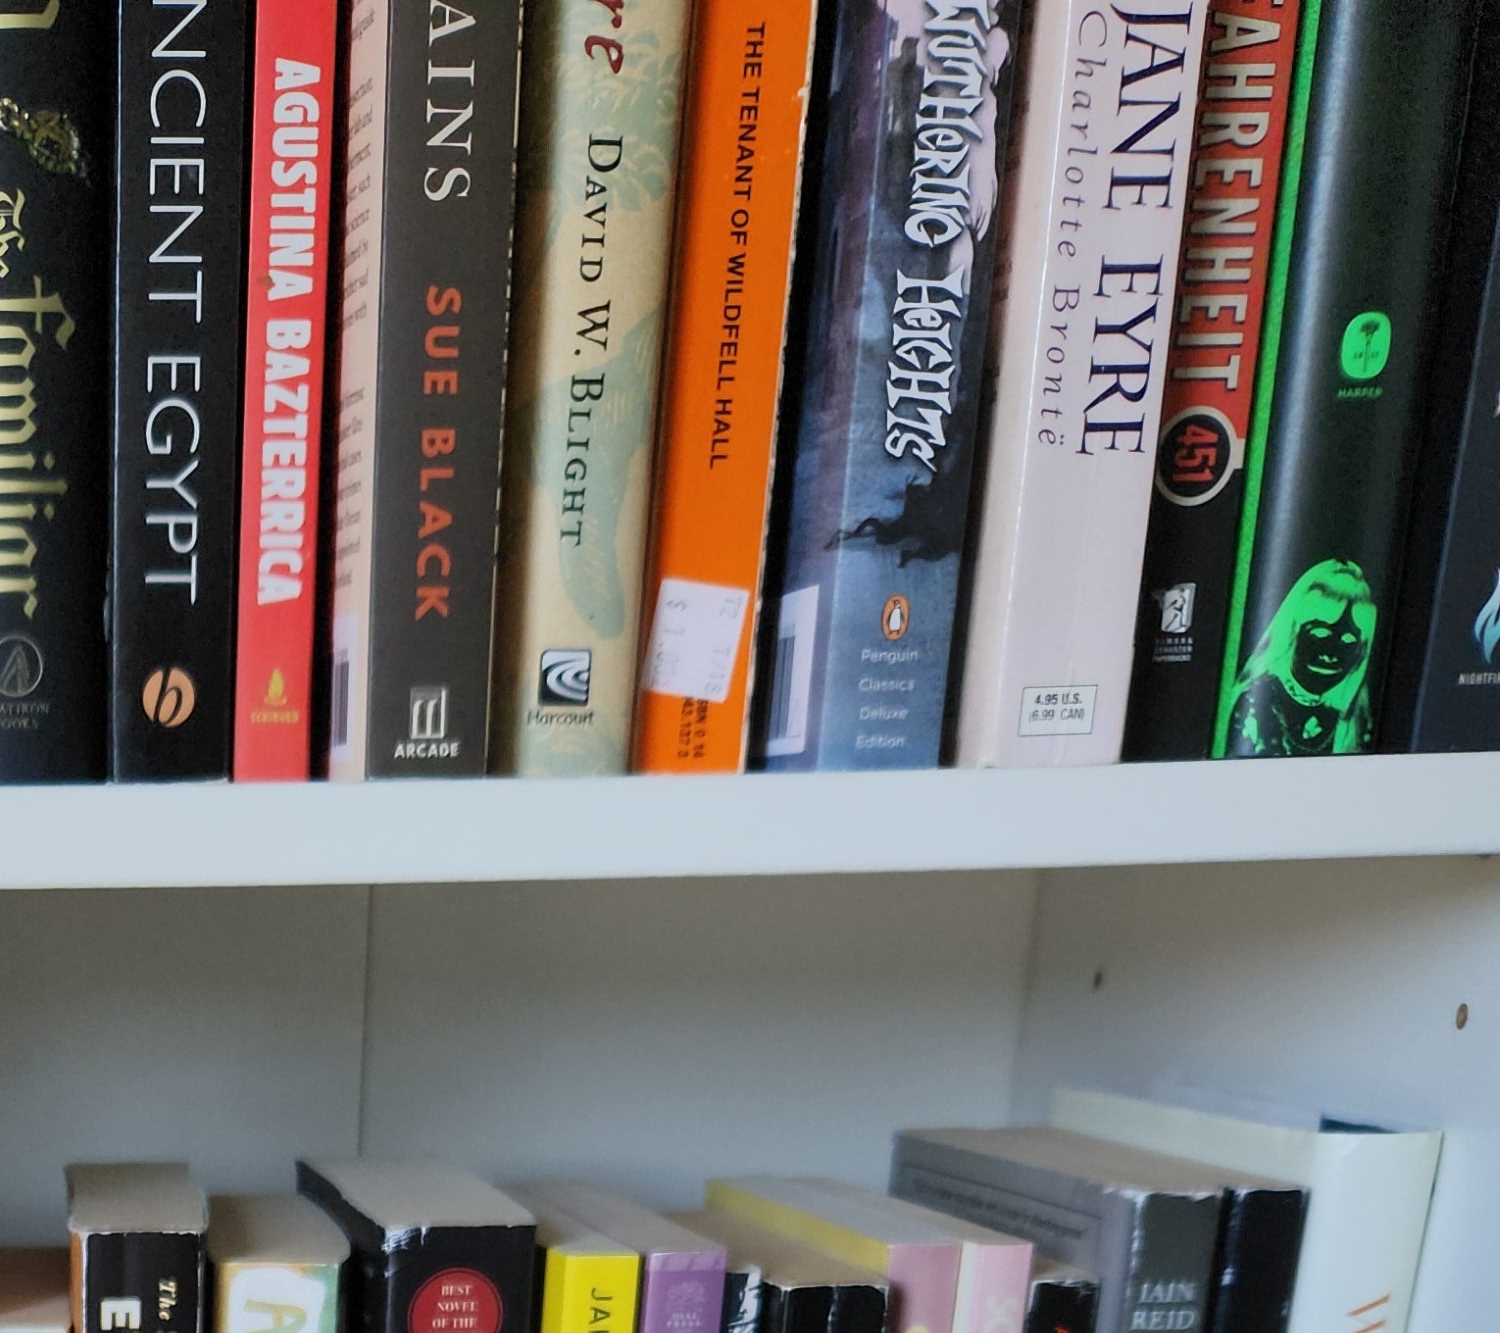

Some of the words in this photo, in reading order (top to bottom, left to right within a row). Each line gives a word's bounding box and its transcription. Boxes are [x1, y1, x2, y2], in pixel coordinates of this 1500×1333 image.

[744, 22, 766, 77] THE
[1056, 8, 1109, 259] Charlotte
[1102, 1, 1193, 212] JANE
[736, 84, 762, 202] TENANT
[265, 58, 320, 302] AGUSTINA
[579, 133, 624, 284] DAVID
[1173, 0, 1286, 392] AHRENHEIT
[729, 209, 751, 247] OF
[424, 285, 462, 395] SUE
[572, 299, 612, 357] W.
[716, 252, 748, 393] WILDFELL
[1036, 283, 1081, 448] Brontë
[1075, 253, 1165, 458] EYRE
[1338, 388, 1383, 399] HARPER
[256, 319, 312, 606] BAZTERRICA
[559, 375, 605, 547] BLIGHT
[709, 399, 734, 470] HALL
[1172, 424, 1222, 483] 451
[142, 355, 202, 604] EGYPT
[414, 428, 456, 621] BLACK
[858, 678, 915, 692] Classics
[861, 650, 919, 665] Penguin
[526, 710, 594, 727] Harcourt
[859, 706, 909, 720] Deluxe
[1034, 693, 1059, 706] 4.95
[393, 743, 461, 759] ARCADE
[855, 735, 906, 749] Edition
[157, 1275, 178, 1321] The
[437, 1300, 479, 1314] NOVEL
[441, 1284, 474, 1297] BEST
[1139, 1280, 1196, 1303] IAIN
[431, 1317, 449, 1330] OF
[452, 1316, 478, 1329] THE
[1129, 1310, 1196, 1331] REID
